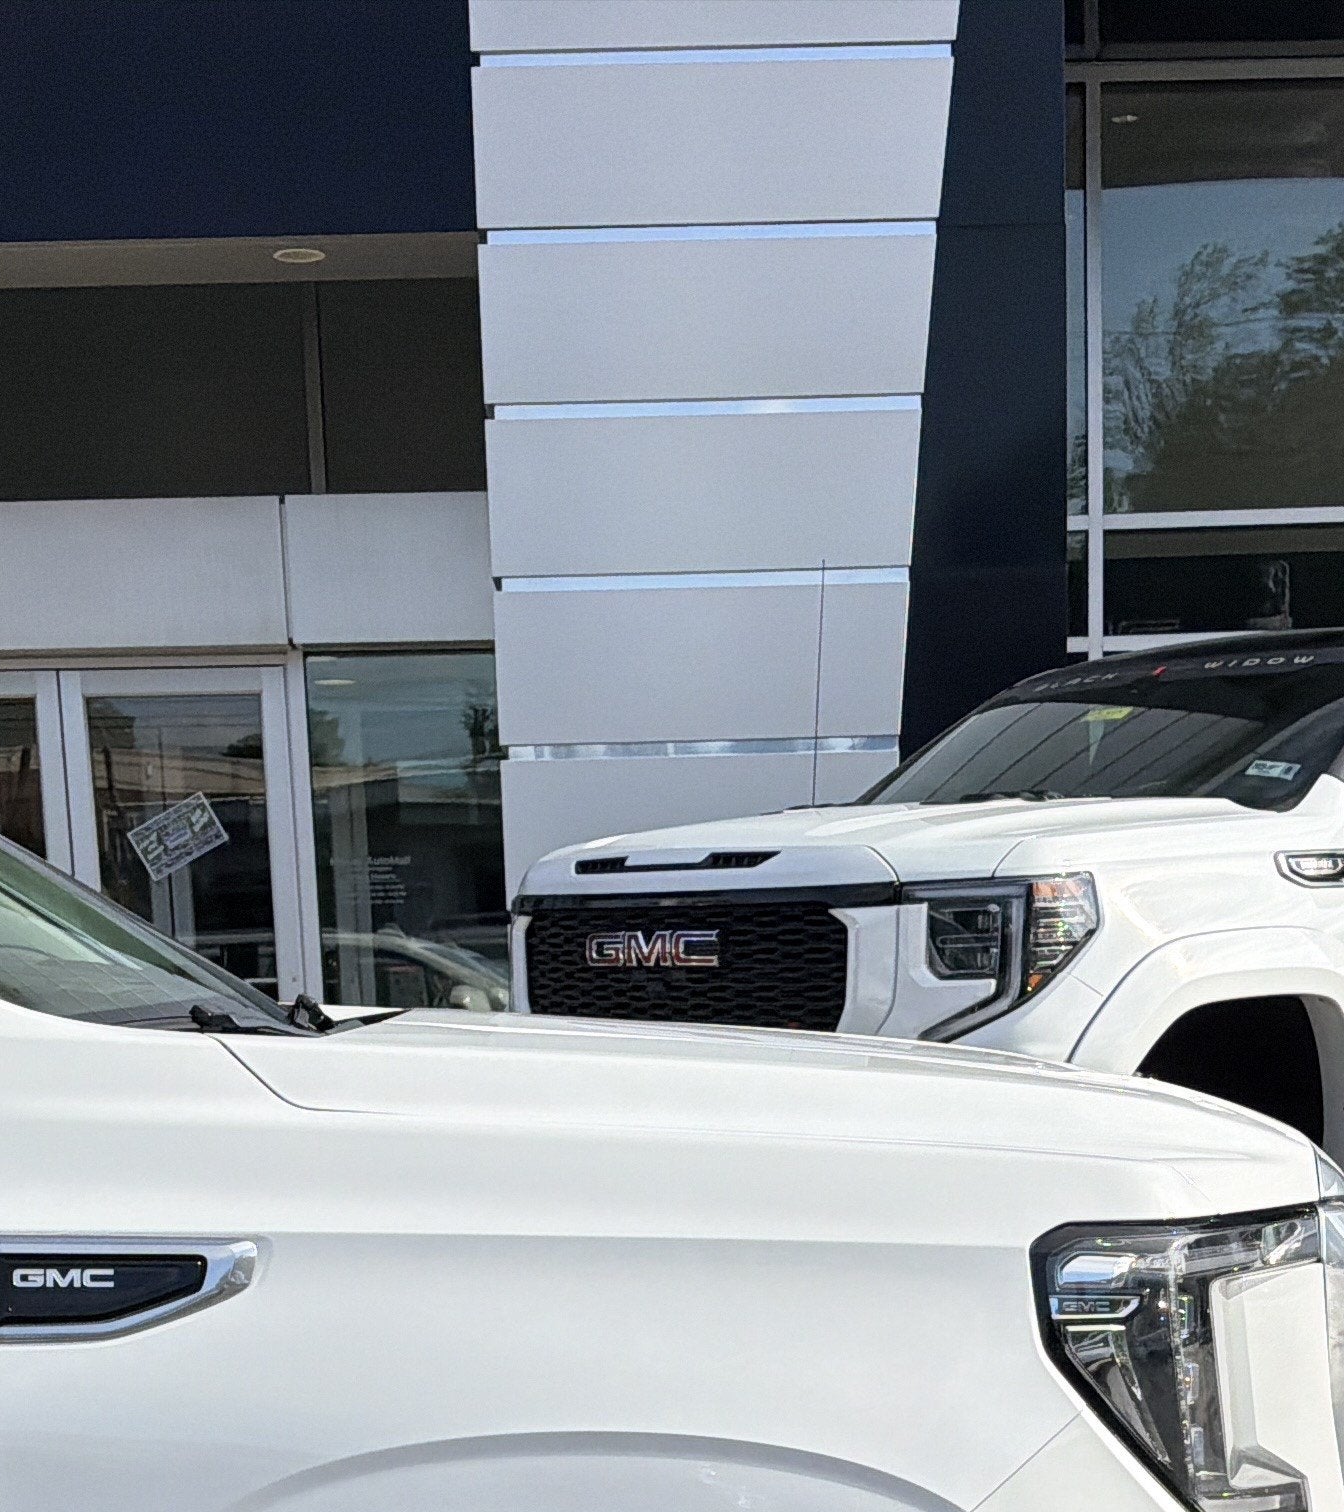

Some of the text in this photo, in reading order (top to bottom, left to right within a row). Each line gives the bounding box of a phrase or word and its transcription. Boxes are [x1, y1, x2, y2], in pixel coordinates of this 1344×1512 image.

[1203, 654, 1315, 670] WIDOW
[585, 929, 721, 968] GMC
[12, 1268, 115, 1288] GMC
[1062, 1301, 1110, 1313] GMC
